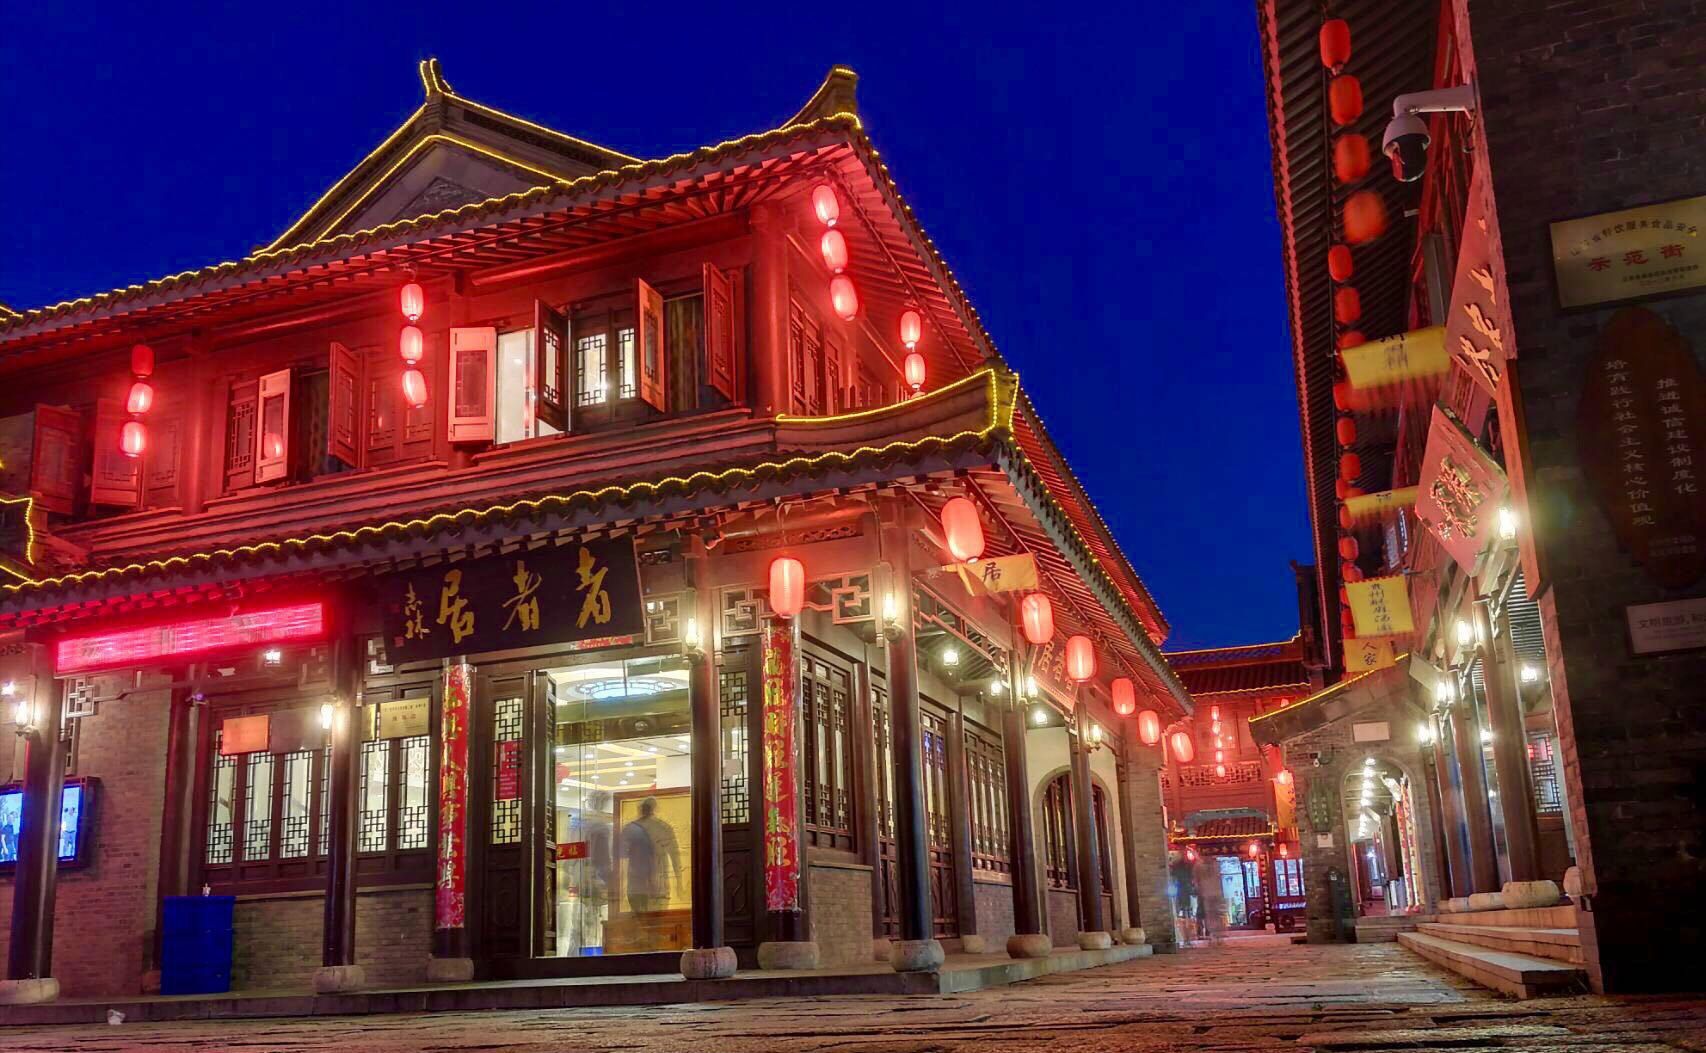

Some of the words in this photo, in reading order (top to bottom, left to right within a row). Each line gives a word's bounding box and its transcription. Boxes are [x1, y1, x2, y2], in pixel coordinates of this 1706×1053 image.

[1655, 378, 1698, 495] 推进诚信建设制度化
